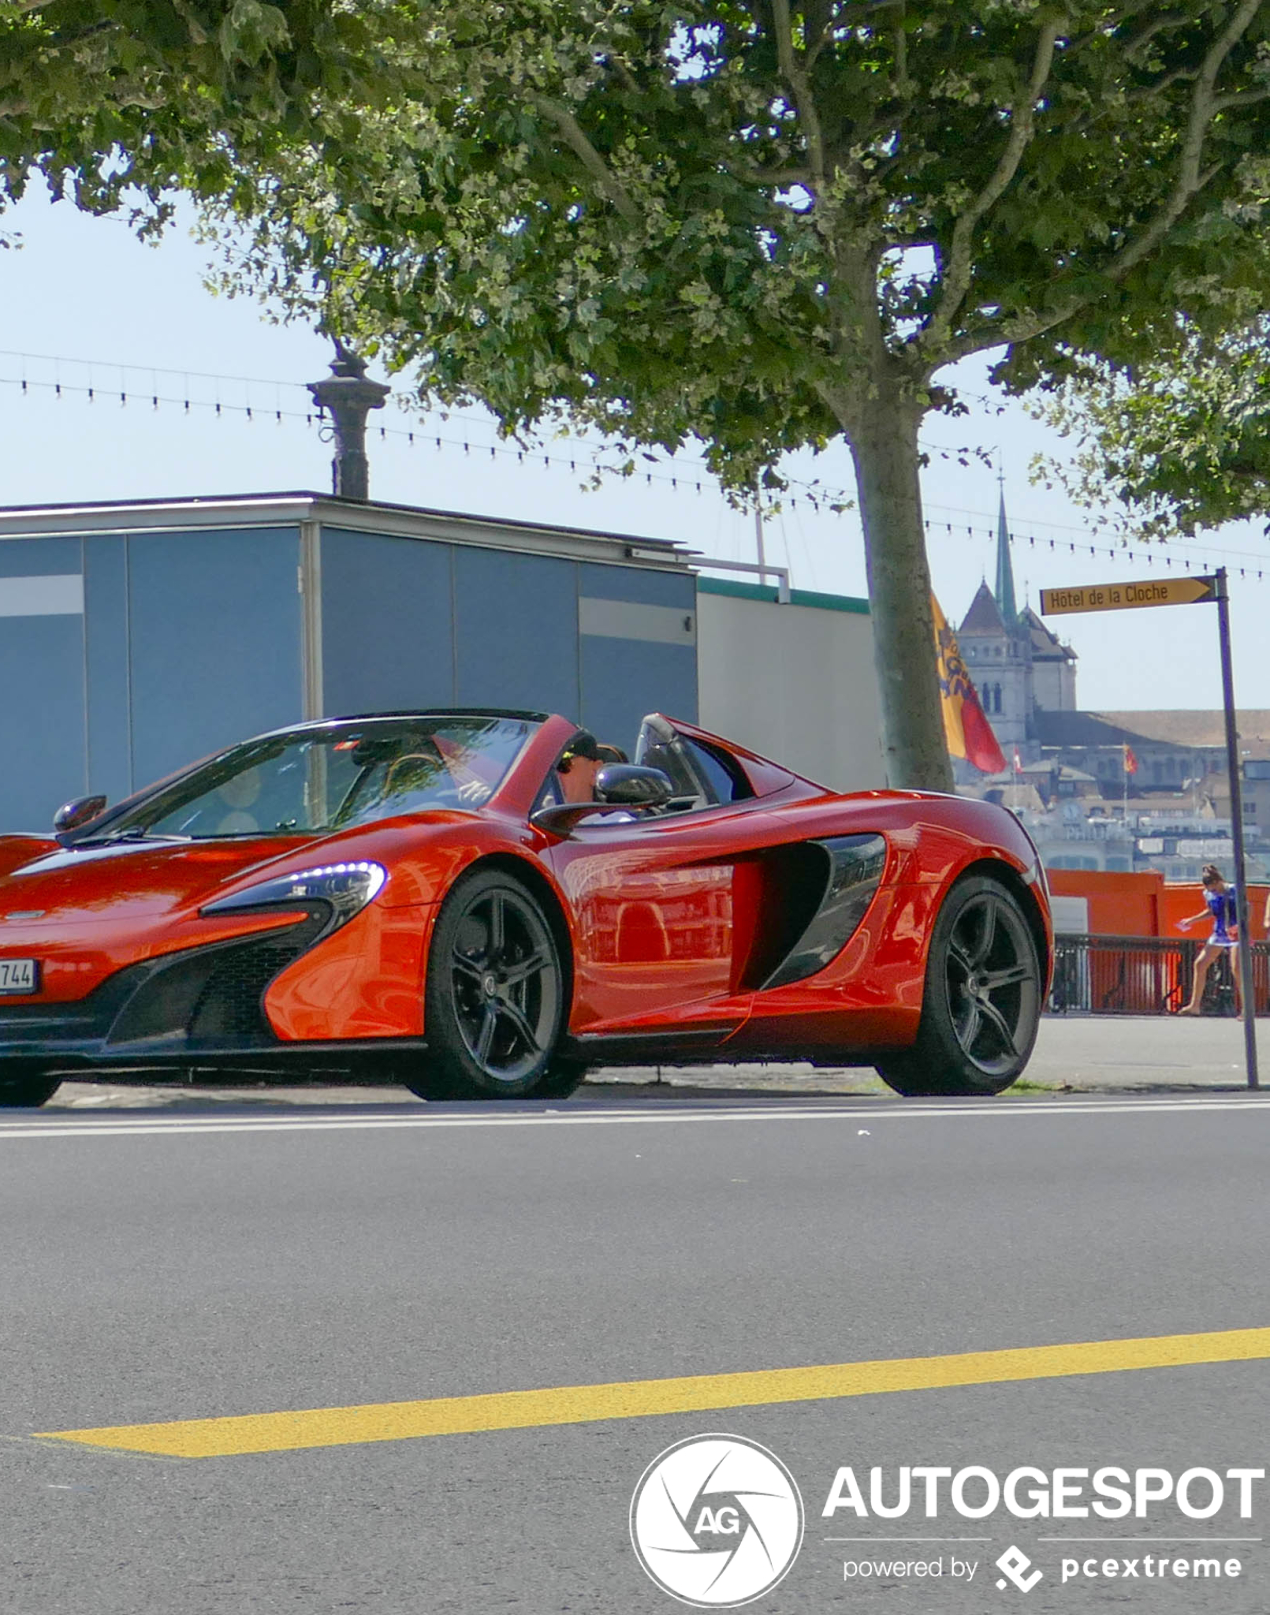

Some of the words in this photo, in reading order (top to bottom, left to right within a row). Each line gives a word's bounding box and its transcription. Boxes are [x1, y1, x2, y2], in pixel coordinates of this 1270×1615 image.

[1050, 591, 1085, 609] Hôtel
[1088, 590, 1104, 606] de
[1108, 588, 1121, 603] la
[1125, 584, 1169, 602] Cloche
